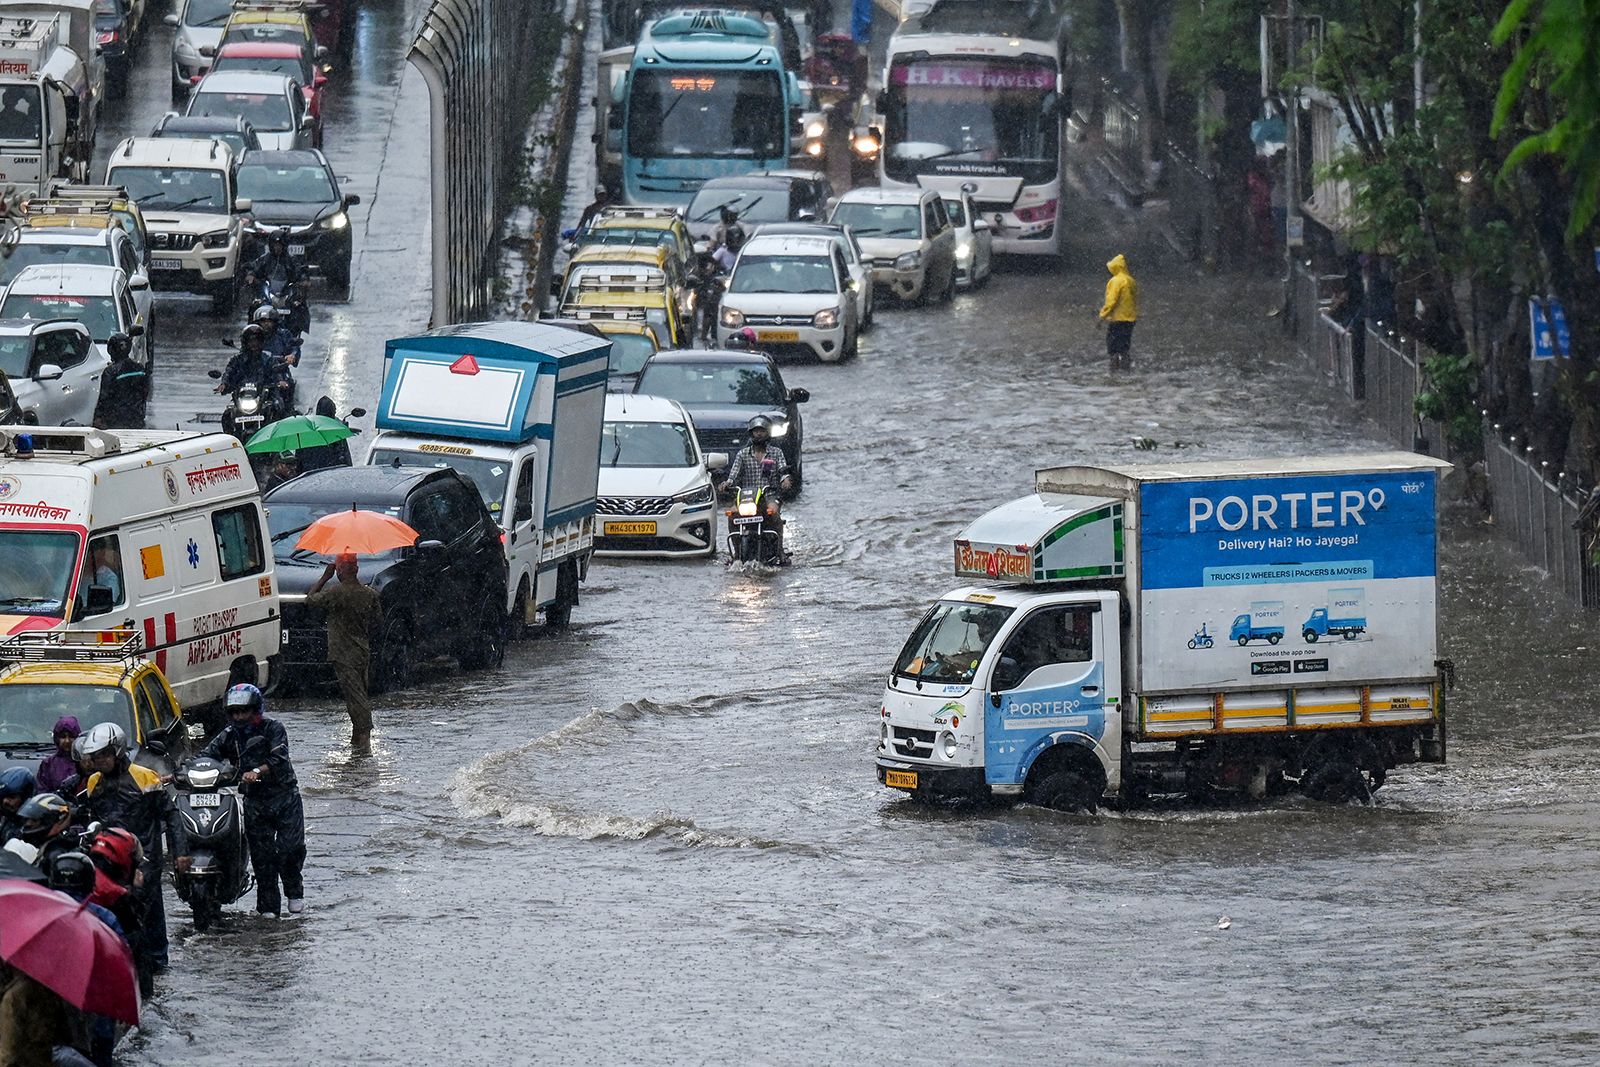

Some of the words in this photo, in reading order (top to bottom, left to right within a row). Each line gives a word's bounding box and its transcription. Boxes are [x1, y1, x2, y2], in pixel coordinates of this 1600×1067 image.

[905, 66, 973, 85] H.K.
[976, 72, 1044, 88] TRAVELS
[420, 444, 443, 452] GOODS
[443, 446, 474, 455] CARRIER
[1189, 490, 1366, 534] PORTER
[1218, 538, 1265, 551] Delivery
[1268, 536, 1293, 548] Hai?
[1296, 536, 1312, 547] Ho
[1315, 534, 1358, 548] Jayega!
[1211, 573, 1241, 581] TRUCKS
[1245, 572, 1250, 580] 2
[1250, 570, 1291, 579] WHEELERS
[1295, 568, 1329, 577] PACKERS
[1330, 568, 1336, 576] &
[1336, 567, 1368, 575] MOVERS
[187, 630, 242, 666] AMBULANCE
[1010, 700, 1074, 716] PORTER
[934, 717, 948, 725] GOLD
